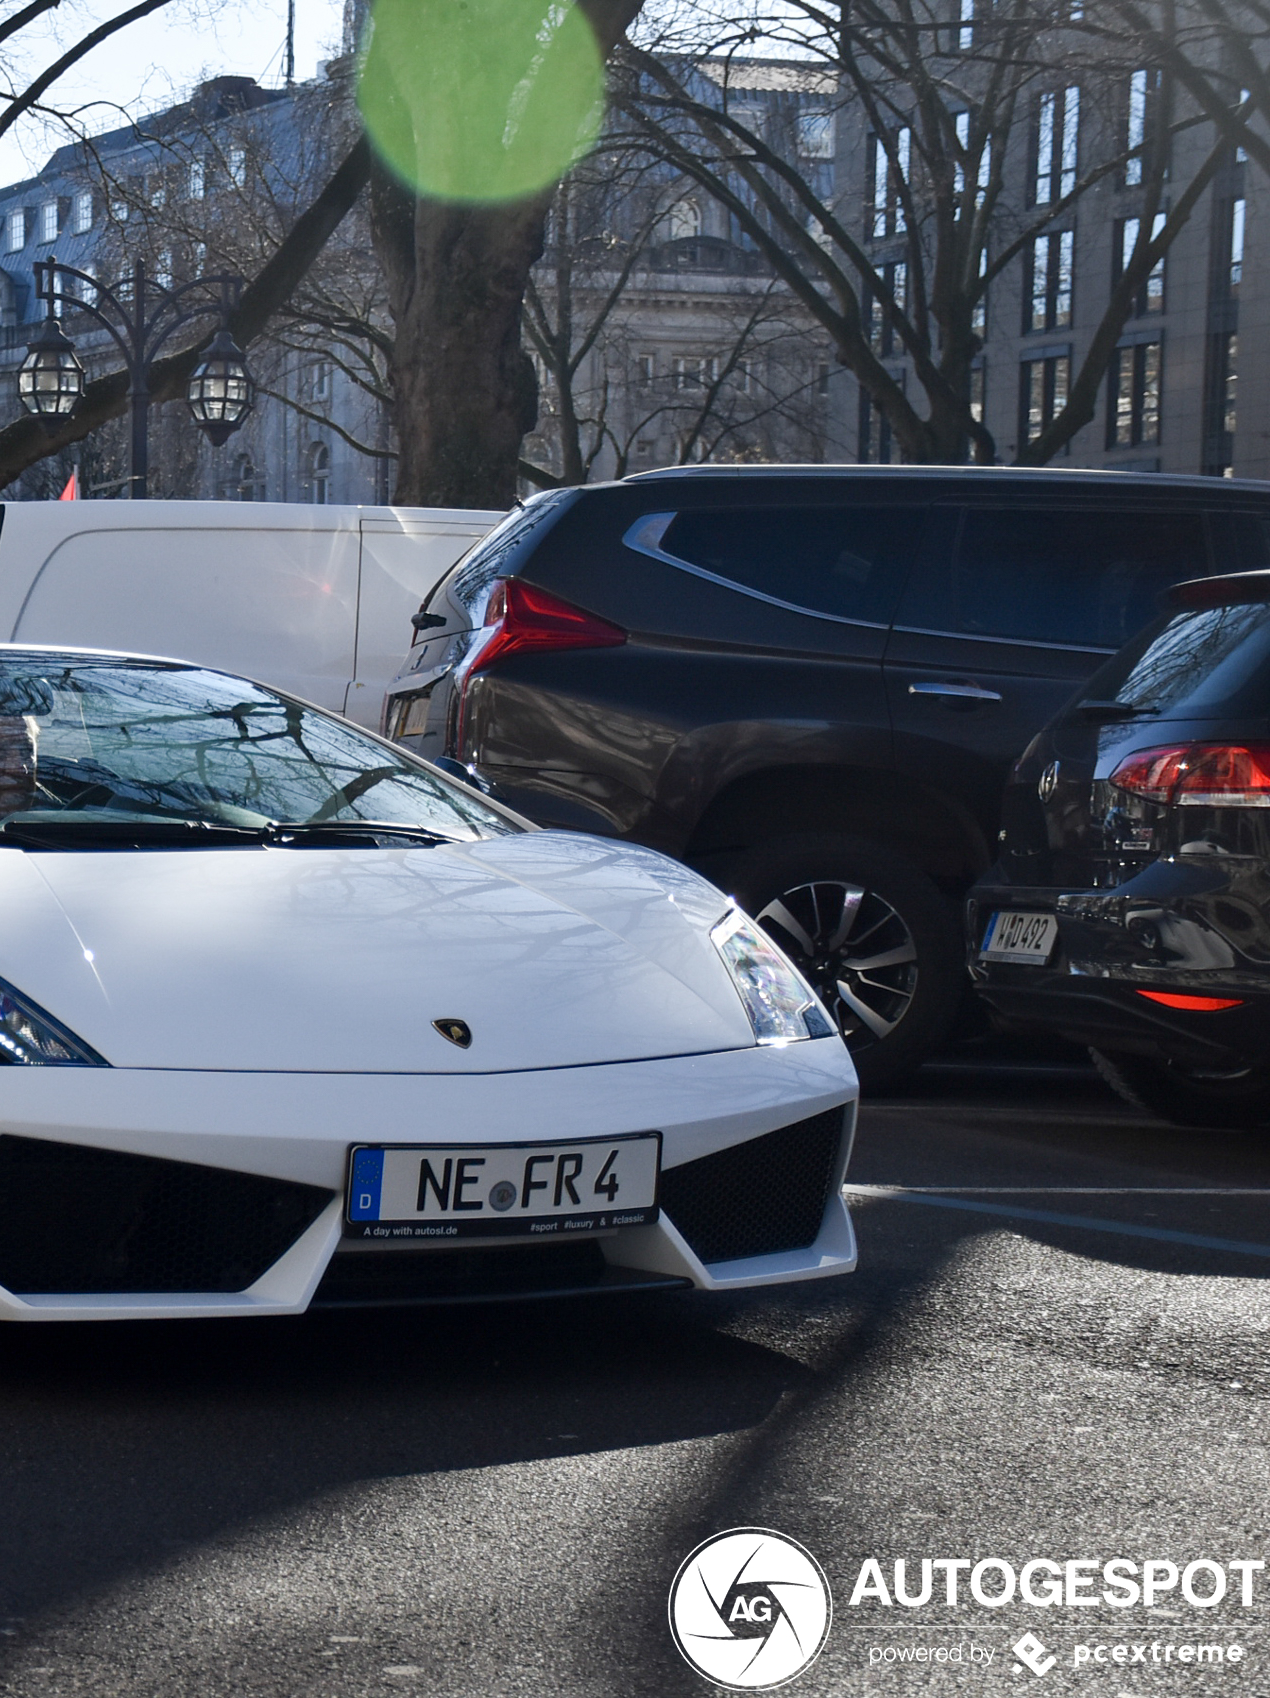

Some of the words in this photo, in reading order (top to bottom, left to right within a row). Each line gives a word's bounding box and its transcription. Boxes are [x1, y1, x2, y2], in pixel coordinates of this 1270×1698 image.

[416, 1157, 486, 1212] NE
[521, 1152, 584, 1209] FR
[593, 1149, 620, 1202] 4
[359, 1193, 372, 1209] D
[363, 1227, 371, 1236] A
[373, 1226, 391, 1237] day
[393, 1226, 413, 1236] with
[530, 1222, 558, 1233] #sport
[564, 1219, 594, 1230] #luxury
[599, 1217, 607, 1226] &
[612, 1214, 645, 1225] #classic
